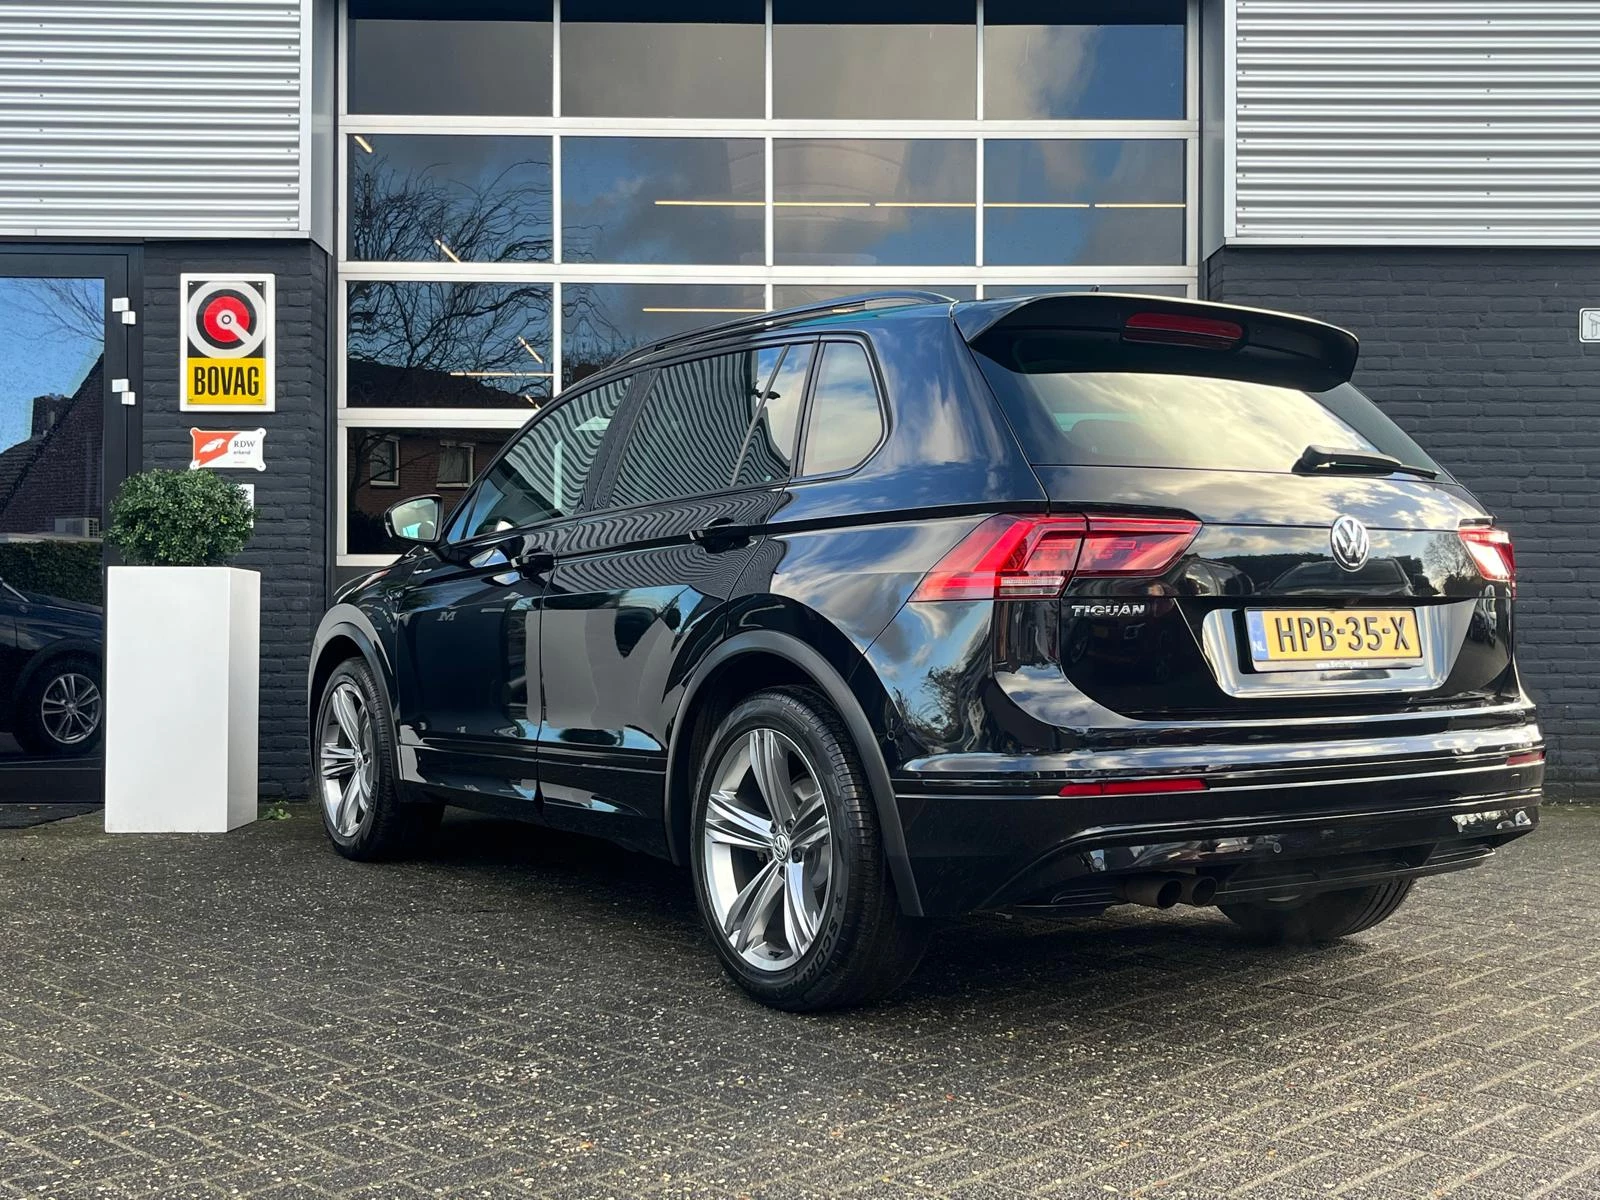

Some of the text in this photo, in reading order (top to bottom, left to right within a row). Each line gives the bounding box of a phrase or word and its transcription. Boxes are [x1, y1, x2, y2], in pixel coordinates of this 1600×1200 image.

[194, 366, 260, 396] BOVAG
[234, 440, 256, 448] RDW
[1071, 604, 1145, 616] TIGUAN
[1275, 616, 1410, 653] HPB-35-X
[1251, 640, 1266, 652] NL
